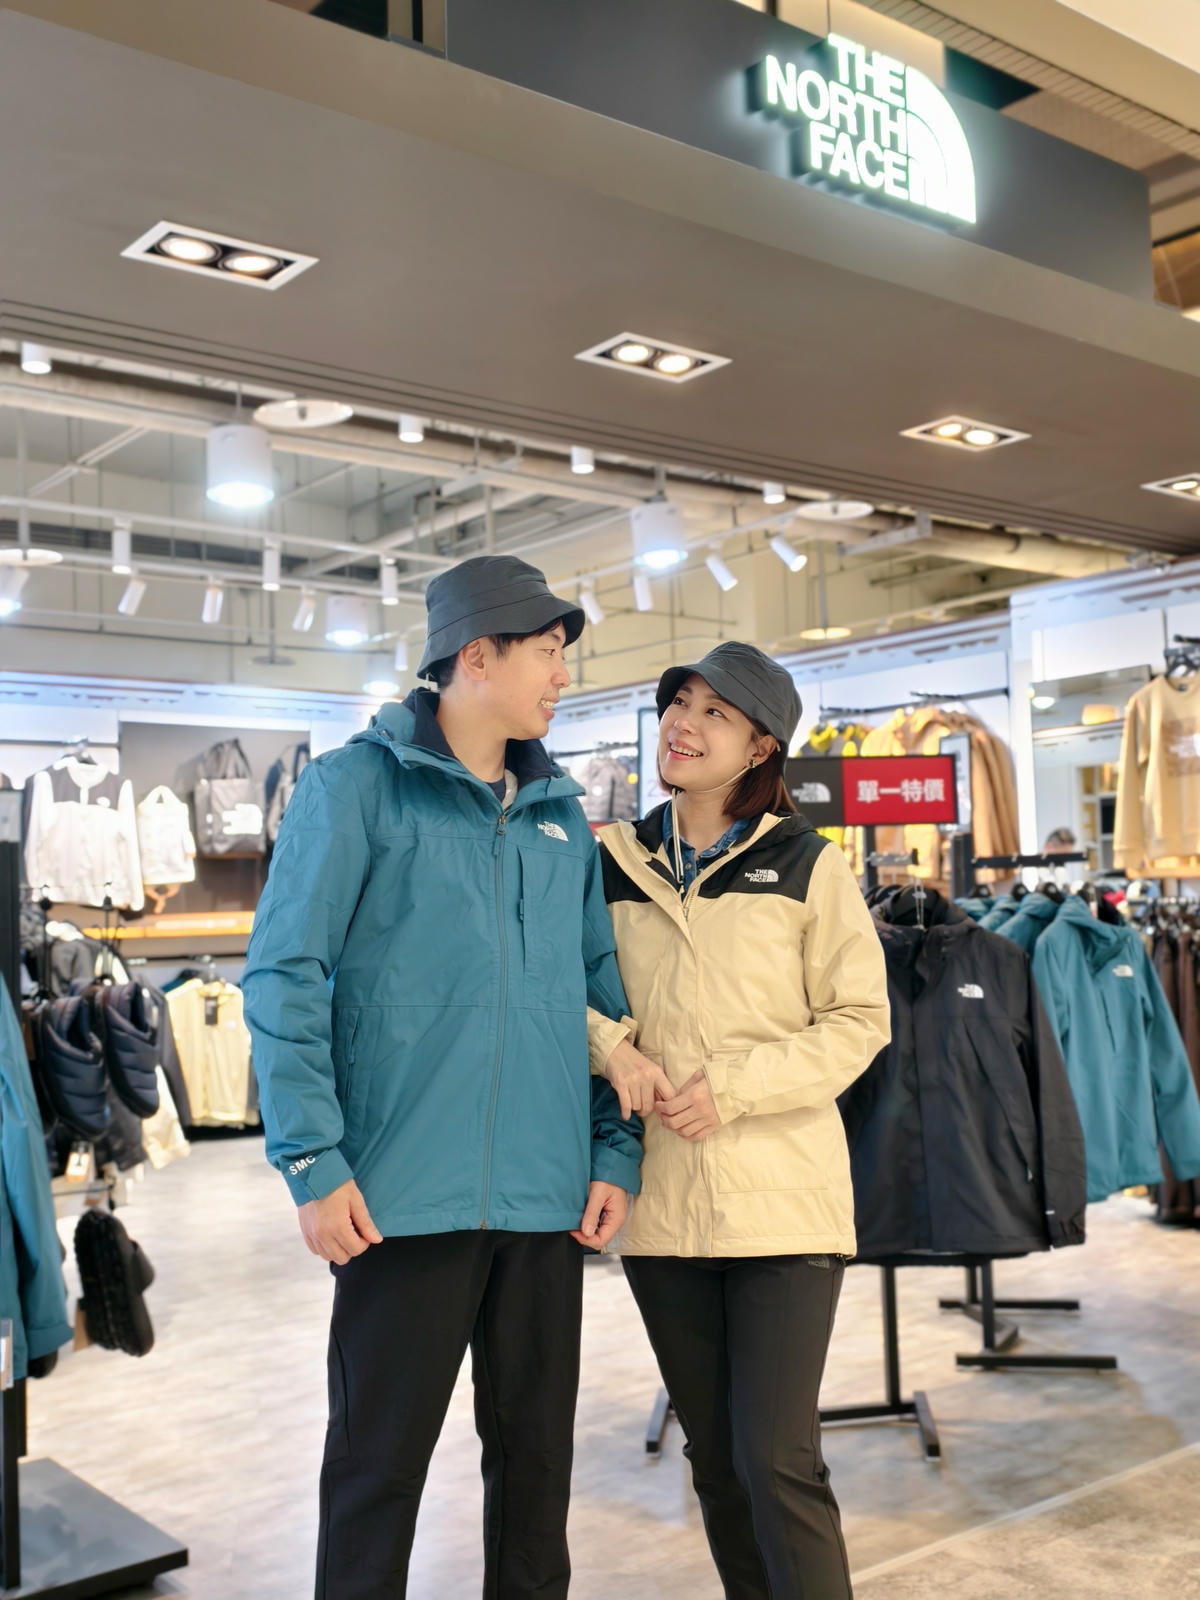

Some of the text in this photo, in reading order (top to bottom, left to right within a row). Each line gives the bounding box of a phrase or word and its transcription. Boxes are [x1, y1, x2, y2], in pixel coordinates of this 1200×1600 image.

[765, 54, 908, 154] NORTH
[827, 32, 906, 109] THE
[809, 120, 909, 200] FACE
[857, 778, 946, 804] 單一特價
